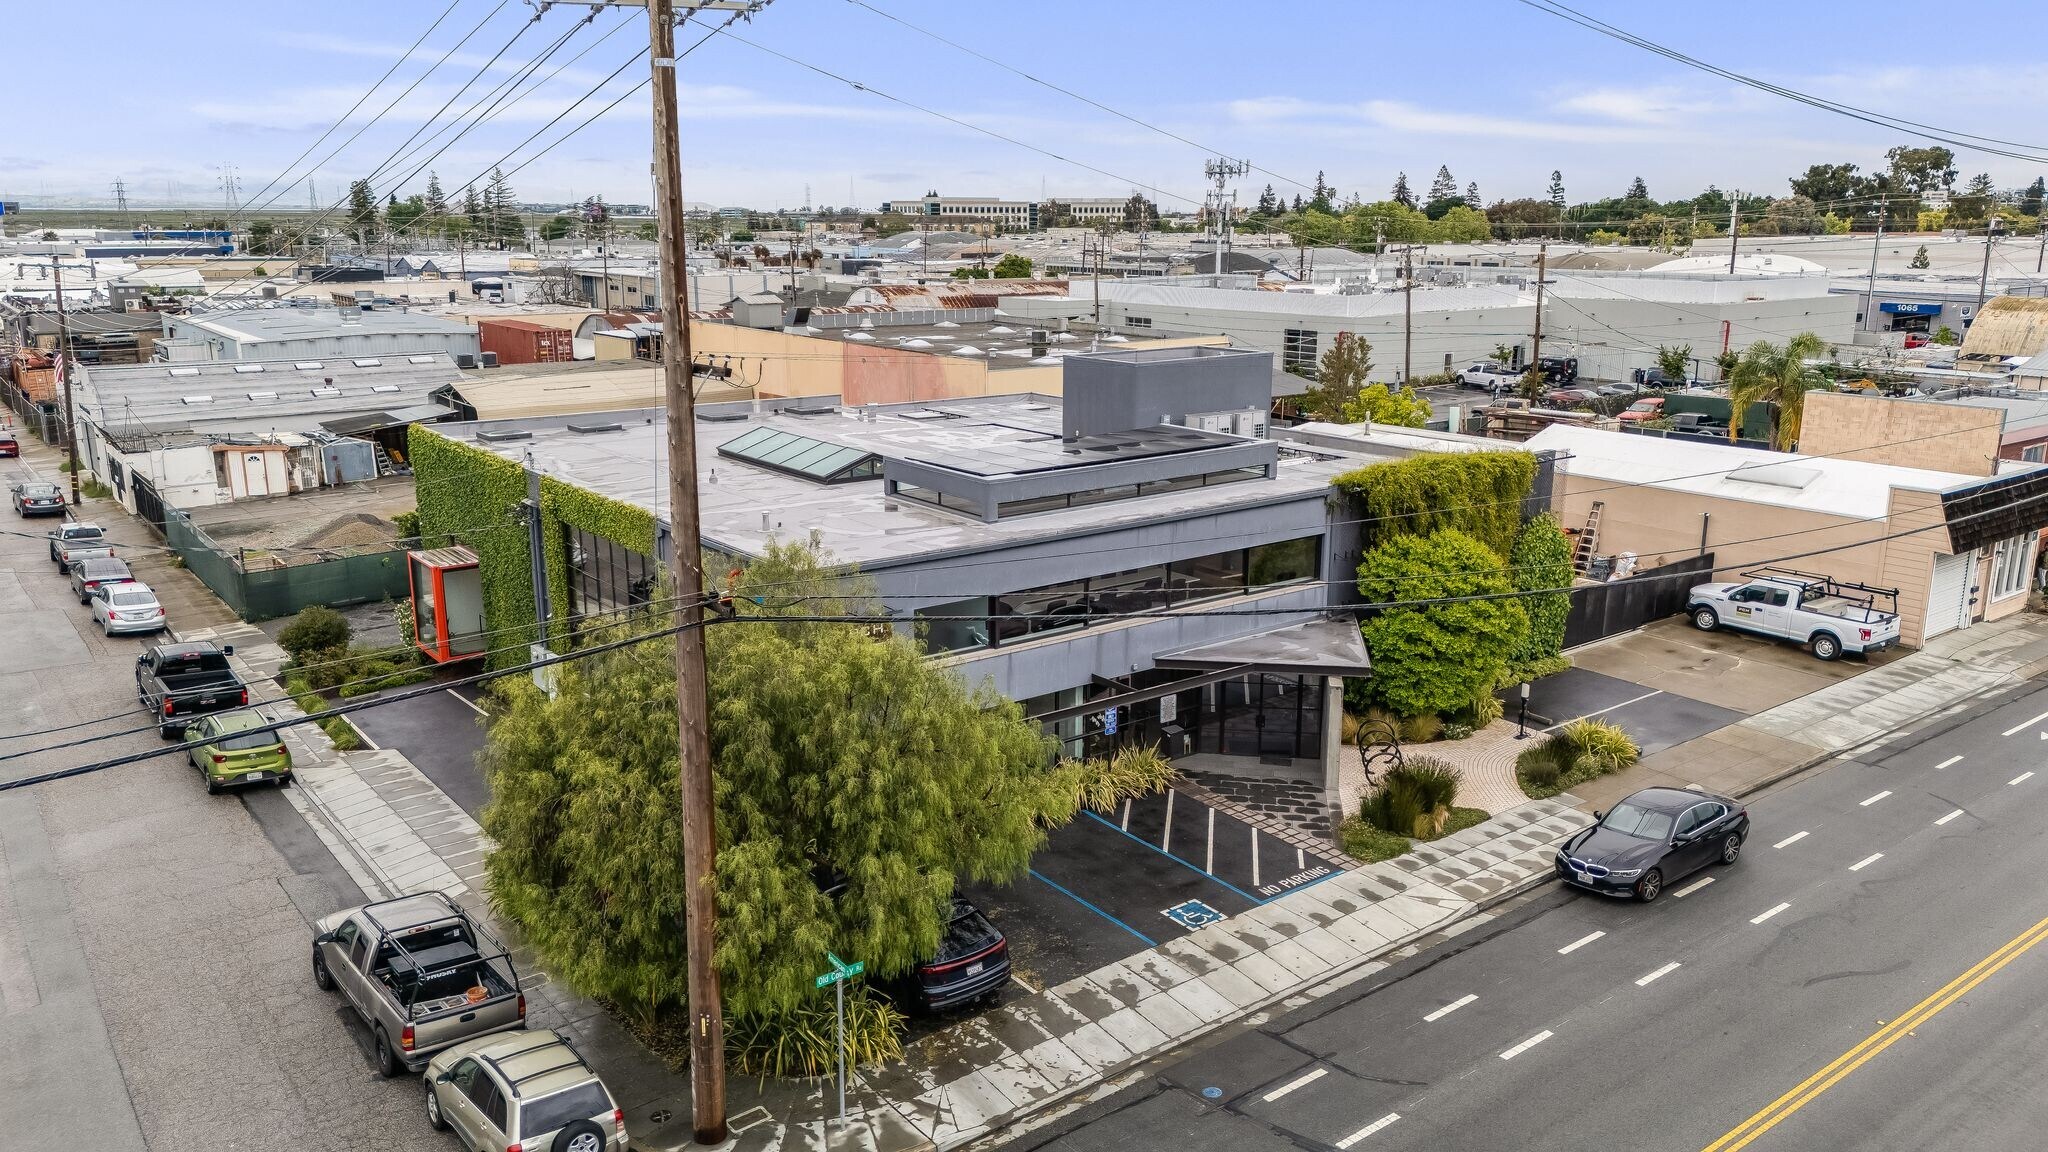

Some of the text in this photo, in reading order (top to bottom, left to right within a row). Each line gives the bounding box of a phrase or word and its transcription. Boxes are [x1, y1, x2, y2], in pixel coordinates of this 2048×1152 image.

[1258, 866, 1330, 896] NO PARKING
[431, 969, 457, 979] HUSKY
[818, 975, 829, 985] Old
